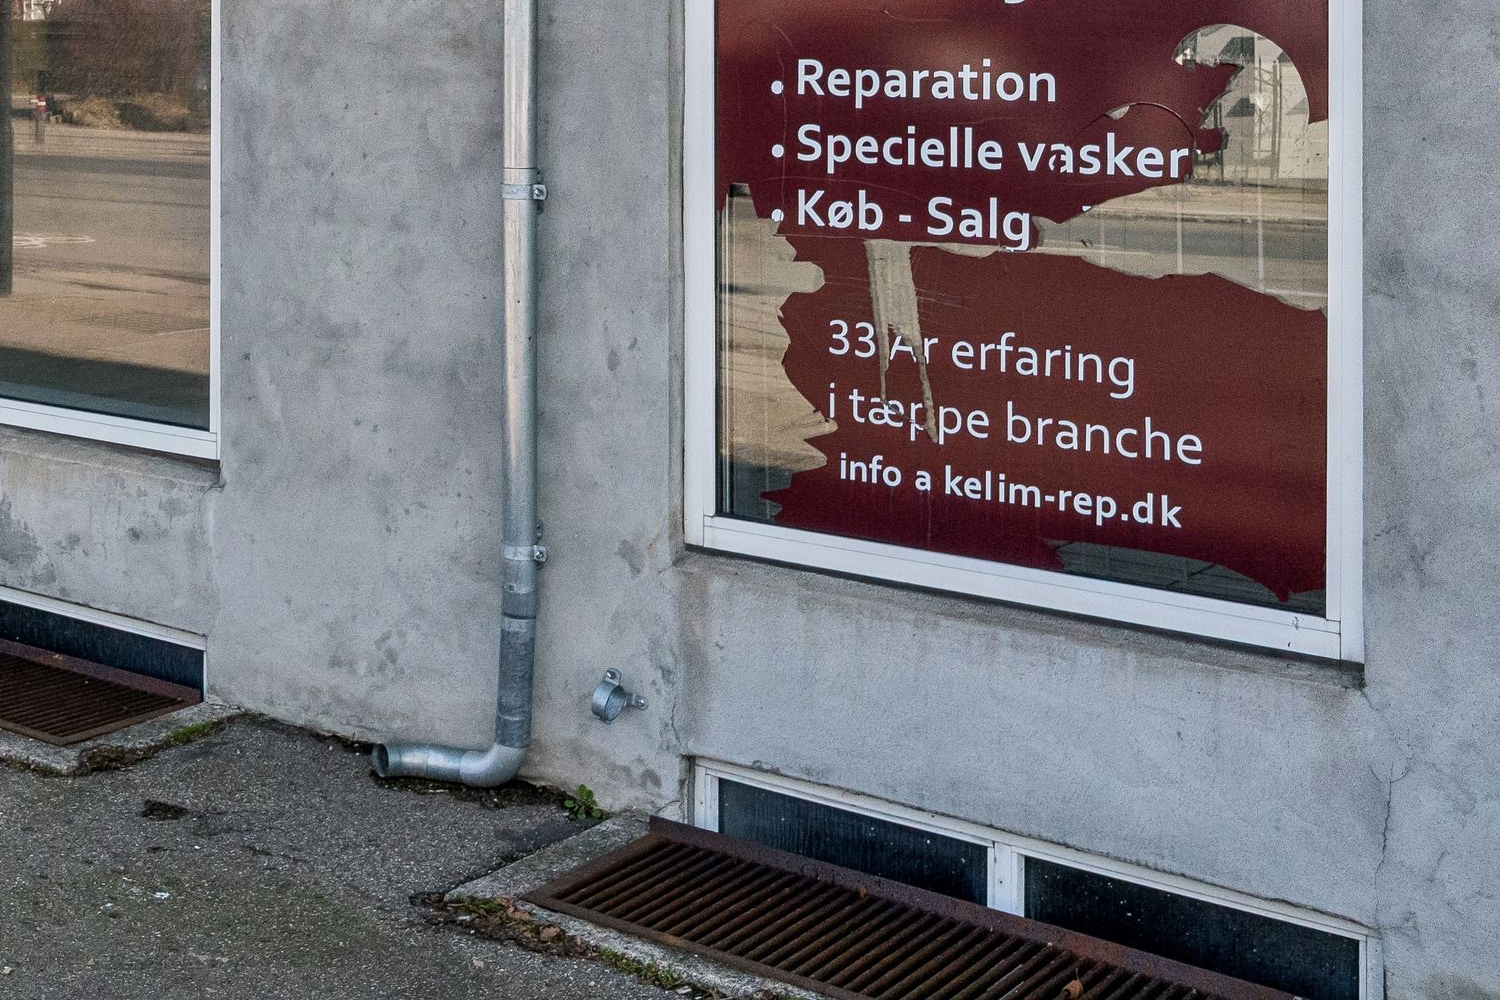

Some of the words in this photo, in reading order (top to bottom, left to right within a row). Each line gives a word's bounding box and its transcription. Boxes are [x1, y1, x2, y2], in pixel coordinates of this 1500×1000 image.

[797, 58, 1057, 109] Reparation
[797, 124, 1003, 174] Specielle
[1017, 132, 1189, 178] vasker
[798, 189, 883, 231] Køb
[927, 196, 1030, 252] Salg
[828, 319, 877, 358] 33
[951, 331, 1136, 398] erfaring
[828, 382, 836, 419] i
[1006, 401, 1204, 465] branche
[840, 452, 902, 487] info
[915, 470, 932, 492] a
[945, 464, 1183, 529] kelim-rep.dk
